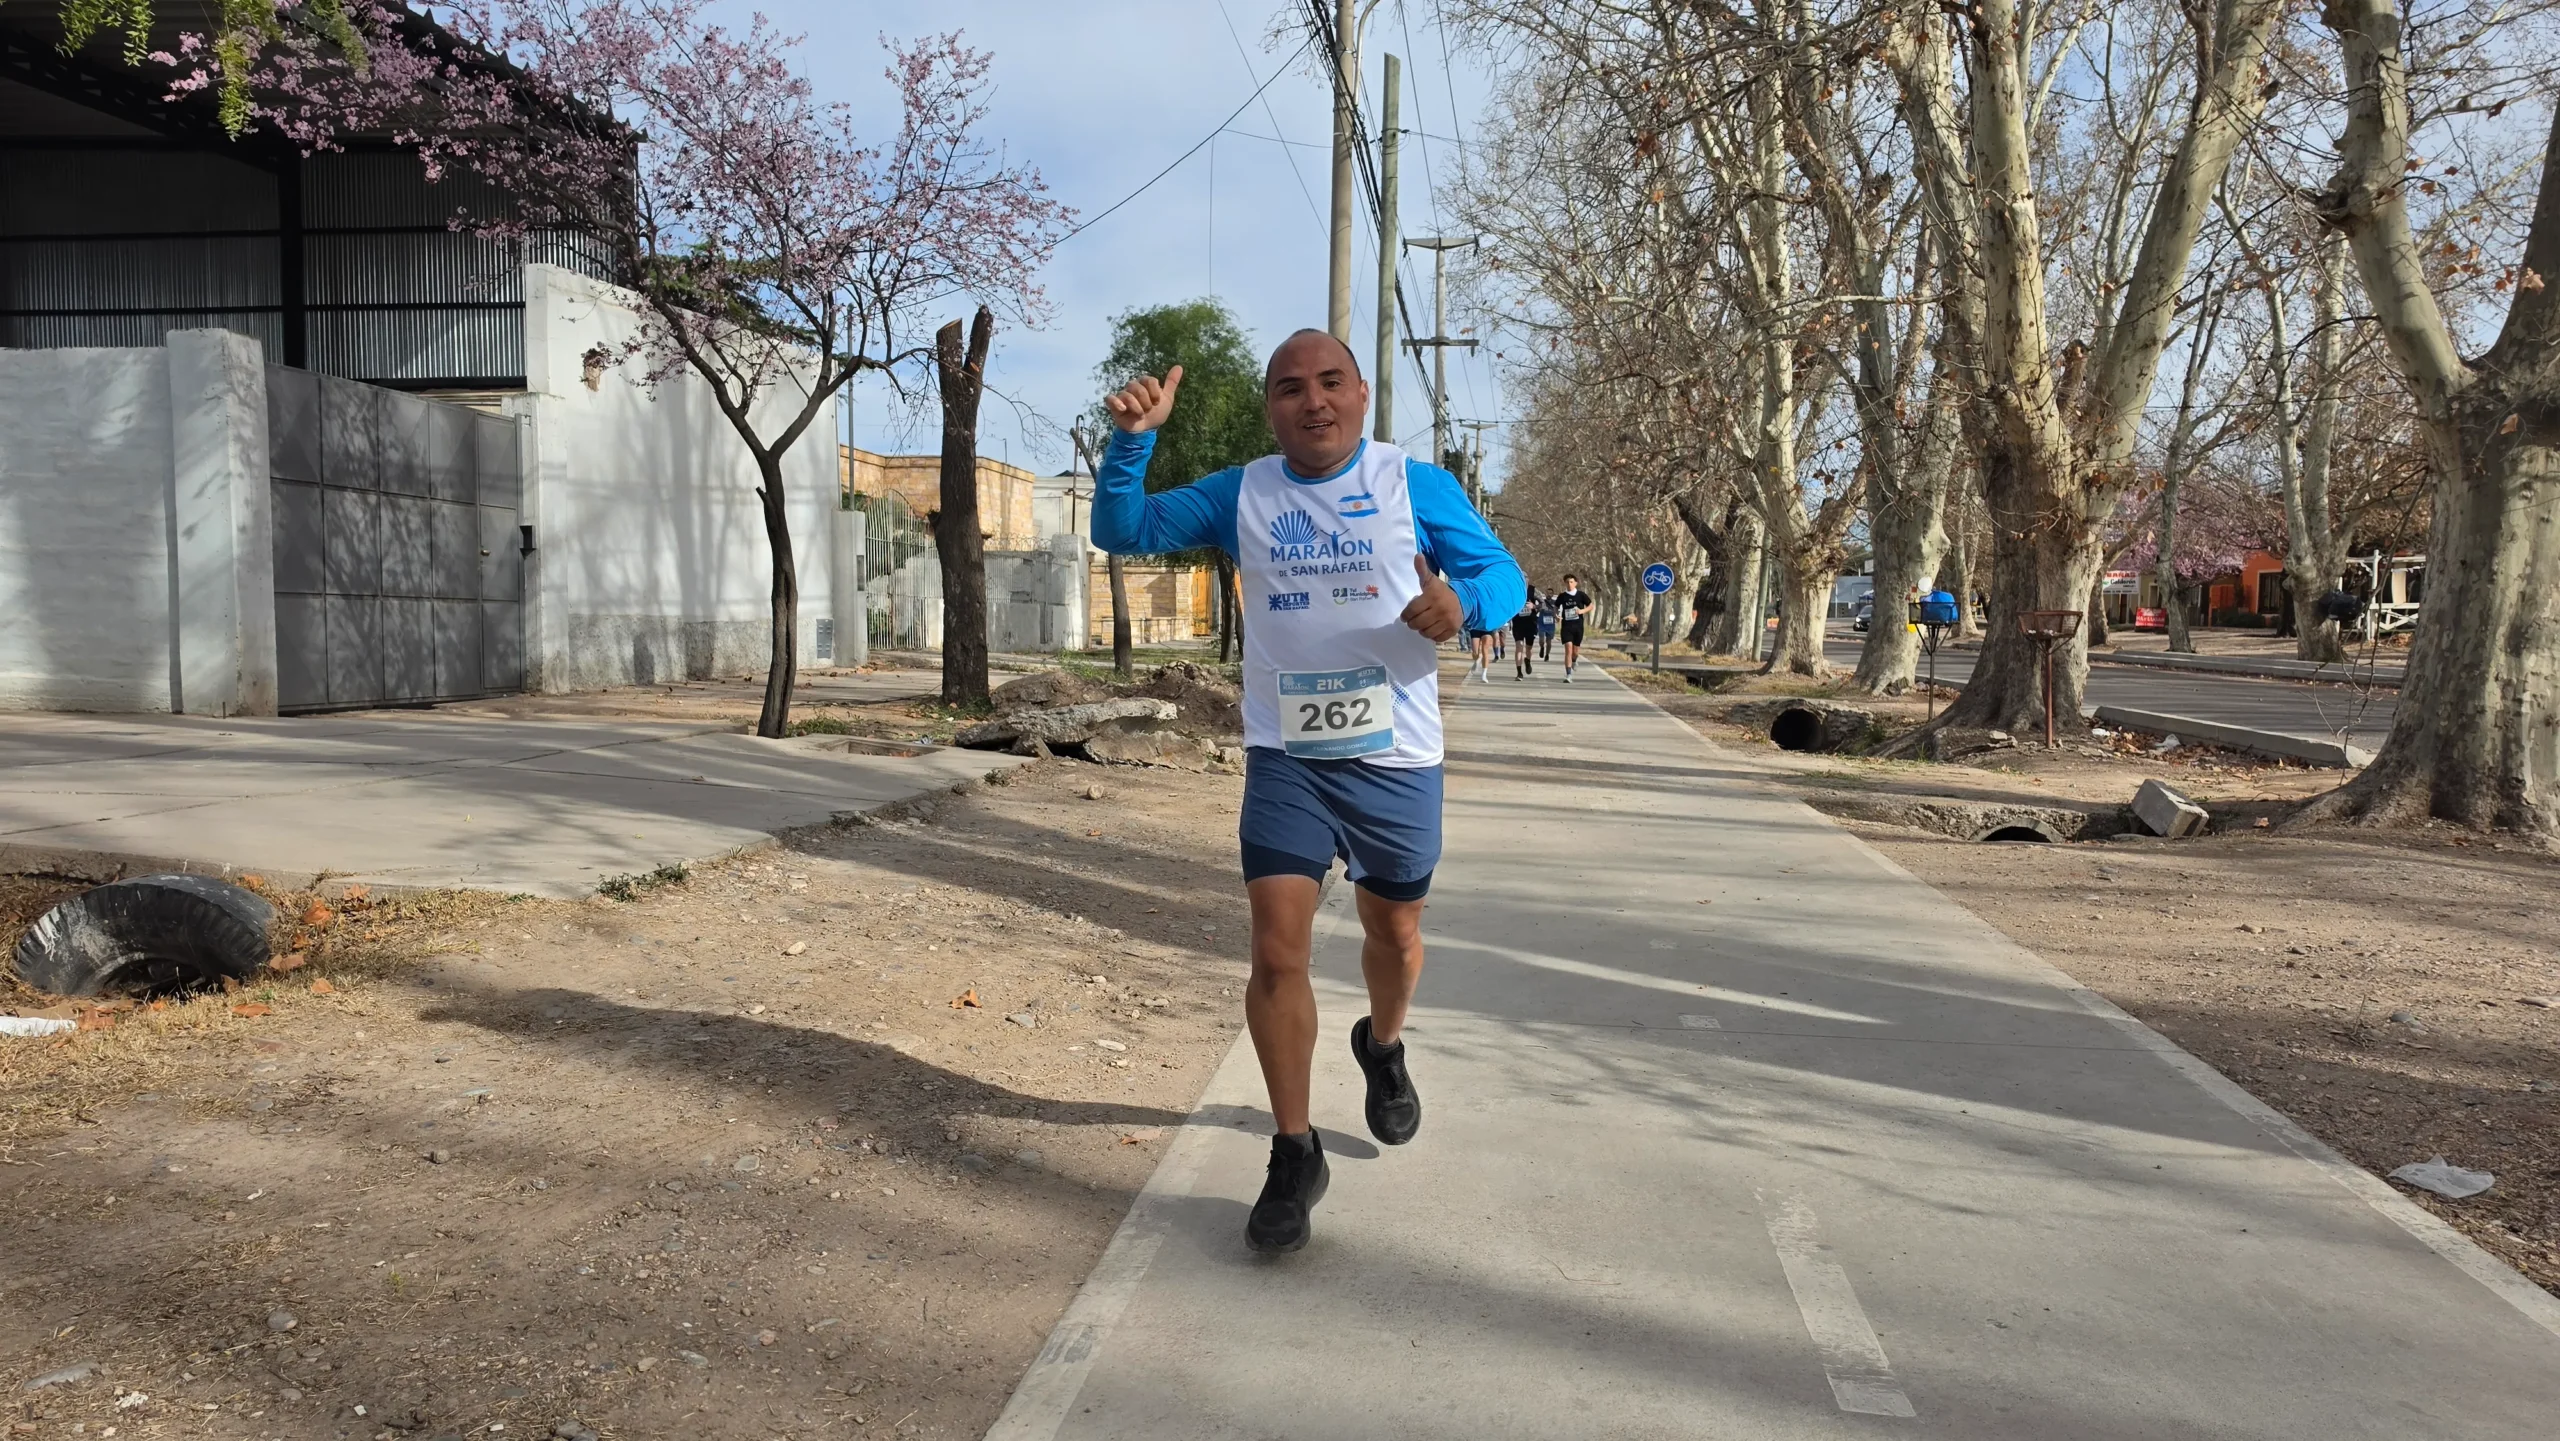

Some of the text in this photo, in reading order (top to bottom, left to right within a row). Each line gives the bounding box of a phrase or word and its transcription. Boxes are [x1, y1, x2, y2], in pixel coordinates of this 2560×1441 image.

[1291, 565, 1318, 577] SAN
[1322, 561, 1374, 575] RAFAEL
[1282, 592, 1309, 603] UTN
[1316, 678, 1346, 691] 21K
[1299, 697, 1373, 732] 262
